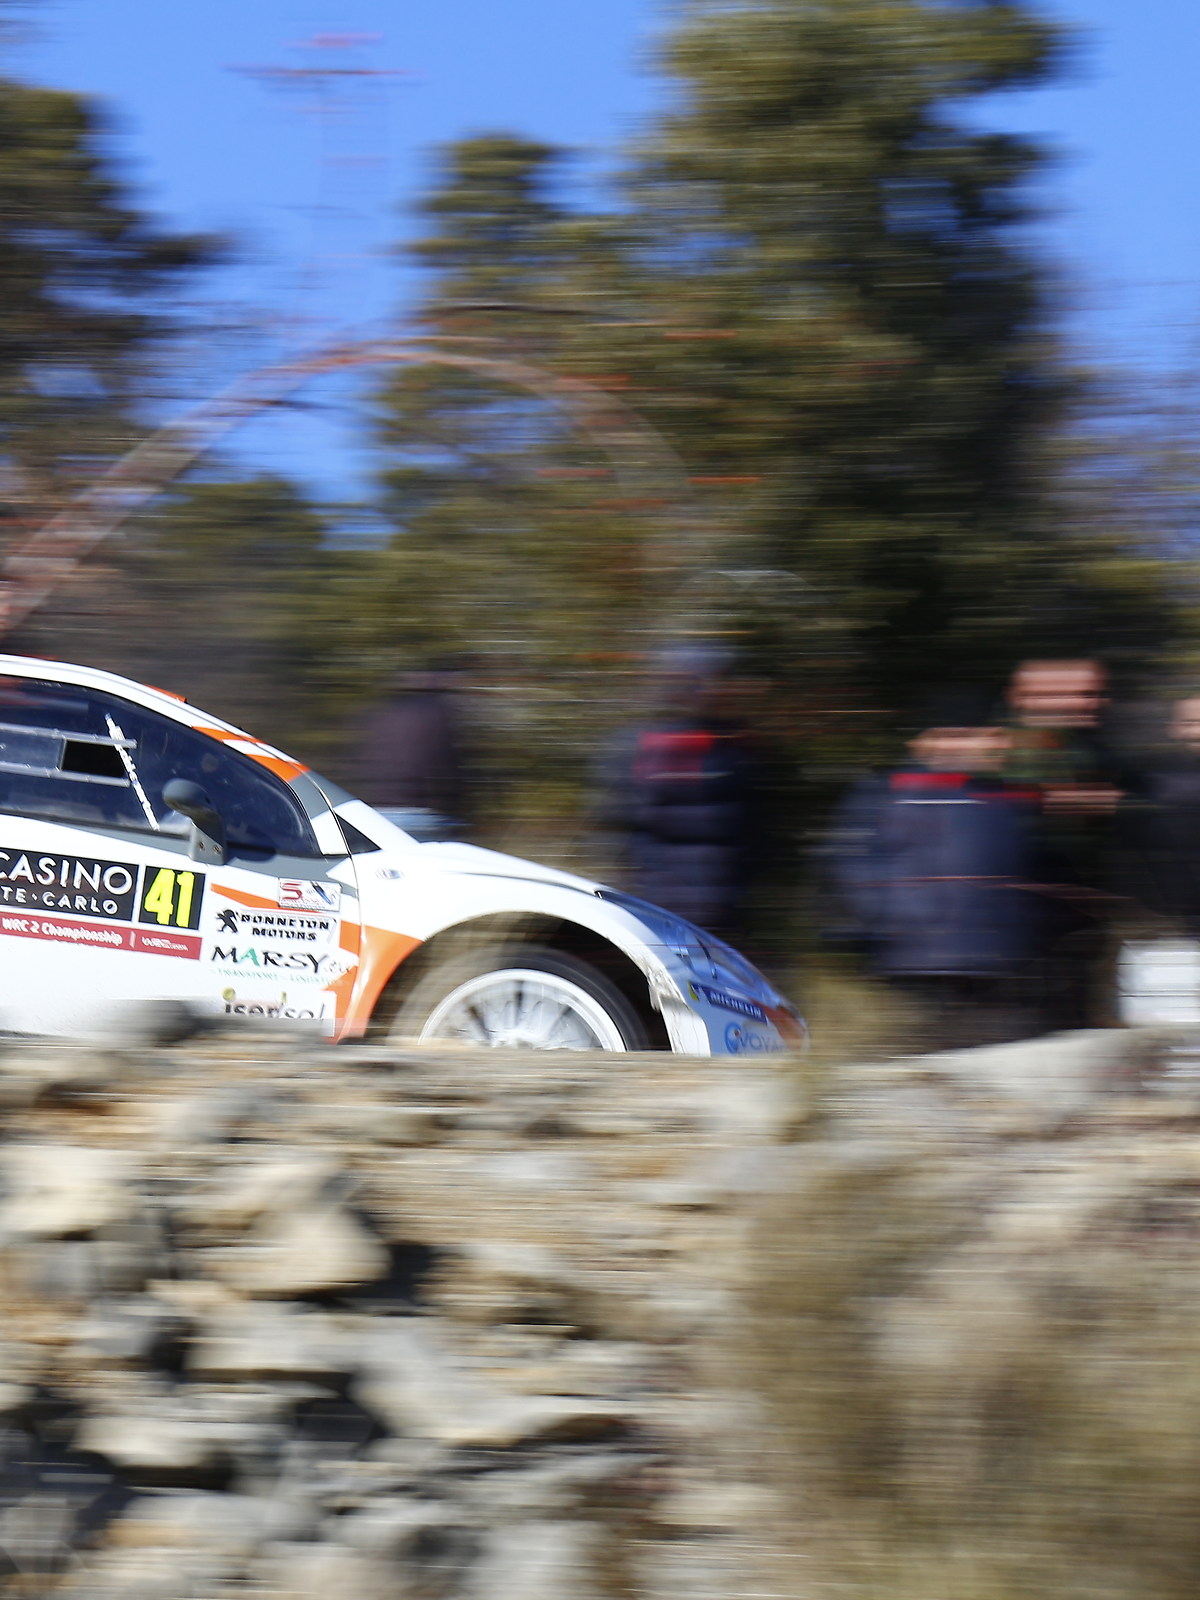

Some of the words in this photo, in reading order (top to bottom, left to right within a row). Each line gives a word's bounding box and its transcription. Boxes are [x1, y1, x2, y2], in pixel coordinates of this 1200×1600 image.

[144, 867, 196, 928] 41
[2, 917, 30, 933] WRC
[30, 920, 40, 934] 2
[41, 922, 123, 946] Championship
